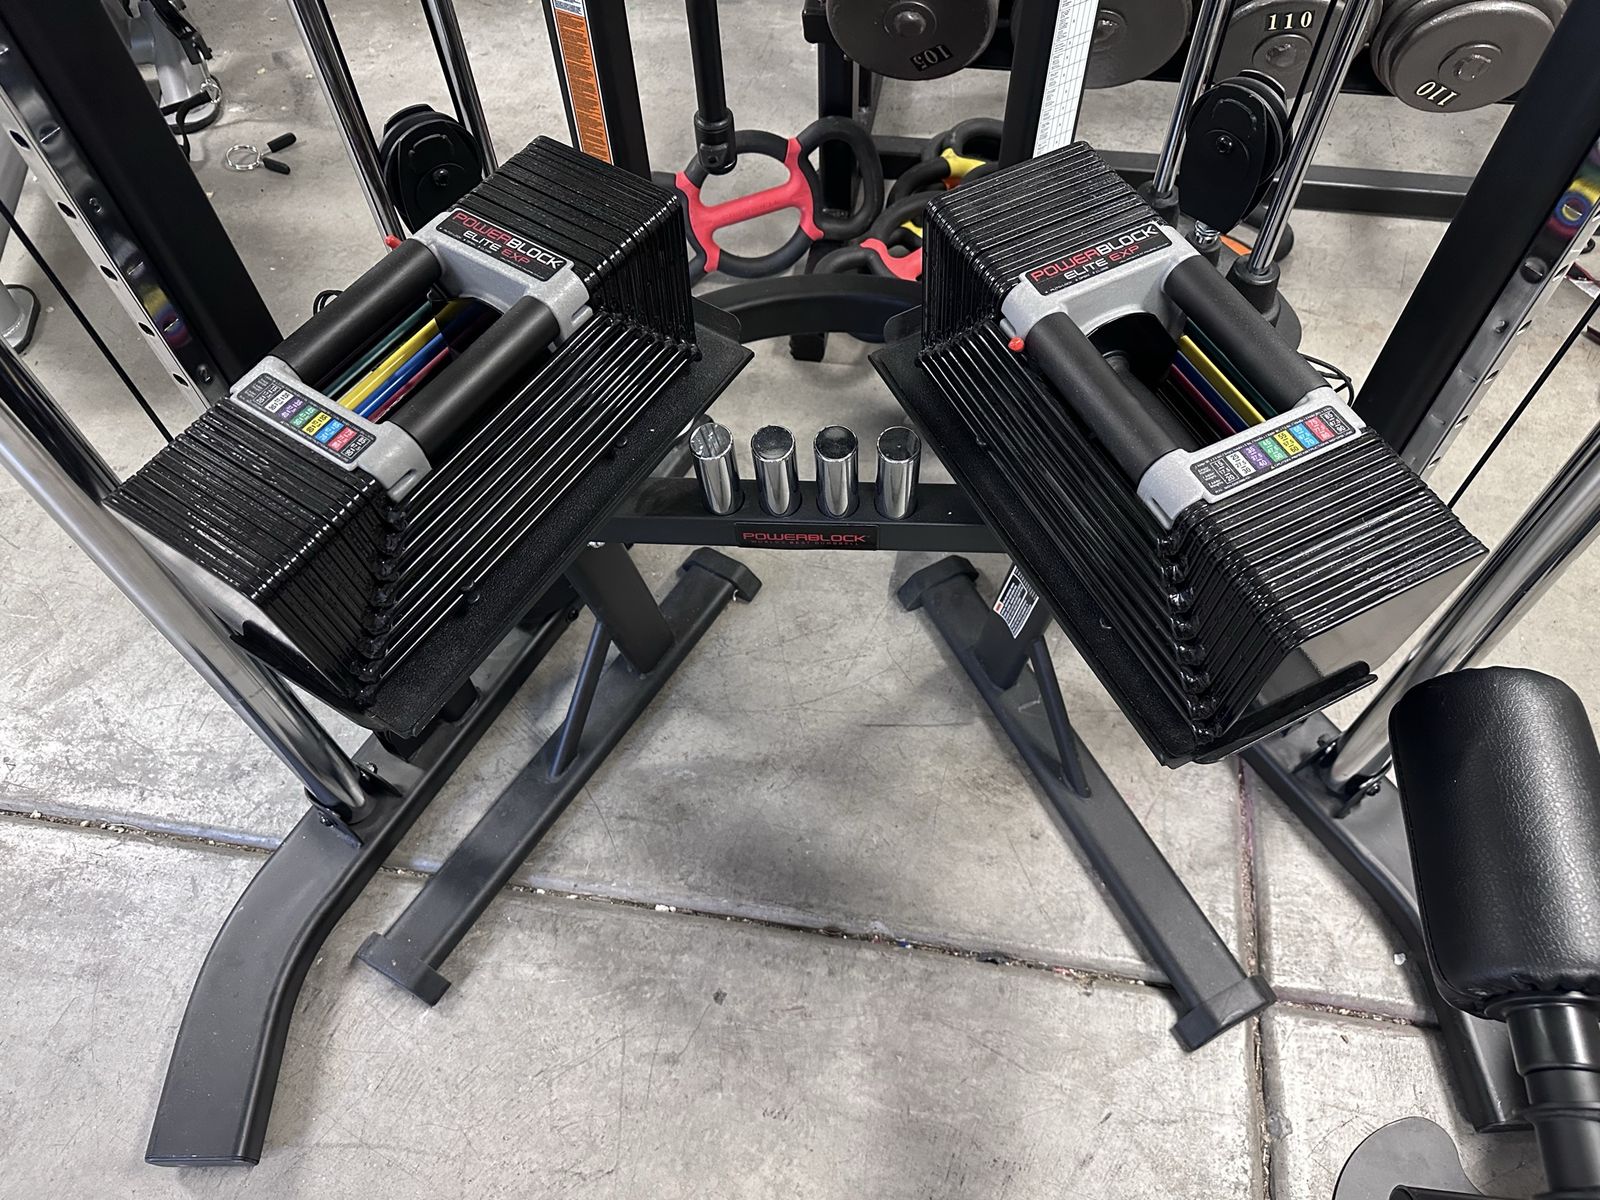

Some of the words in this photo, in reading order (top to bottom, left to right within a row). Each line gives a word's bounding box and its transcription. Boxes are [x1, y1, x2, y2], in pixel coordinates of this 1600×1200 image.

[1268, 11, 1312, 31] 110
[913, 45, 950, 70] 105
[1416, 81, 1458, 106] 110
[453, 212, 563, 269] POWERBLOCK
[463, 230, 502, 251] ELITE
[501, 248, 530, 264] EXP
[1031, 226, 1159, 281] POWERBLOCK
[1064, 258, 1109, 280] ELITE
[1109, 245, 1140, 262] EXP
[743, 532, 866, 542] POWERBLOCK
